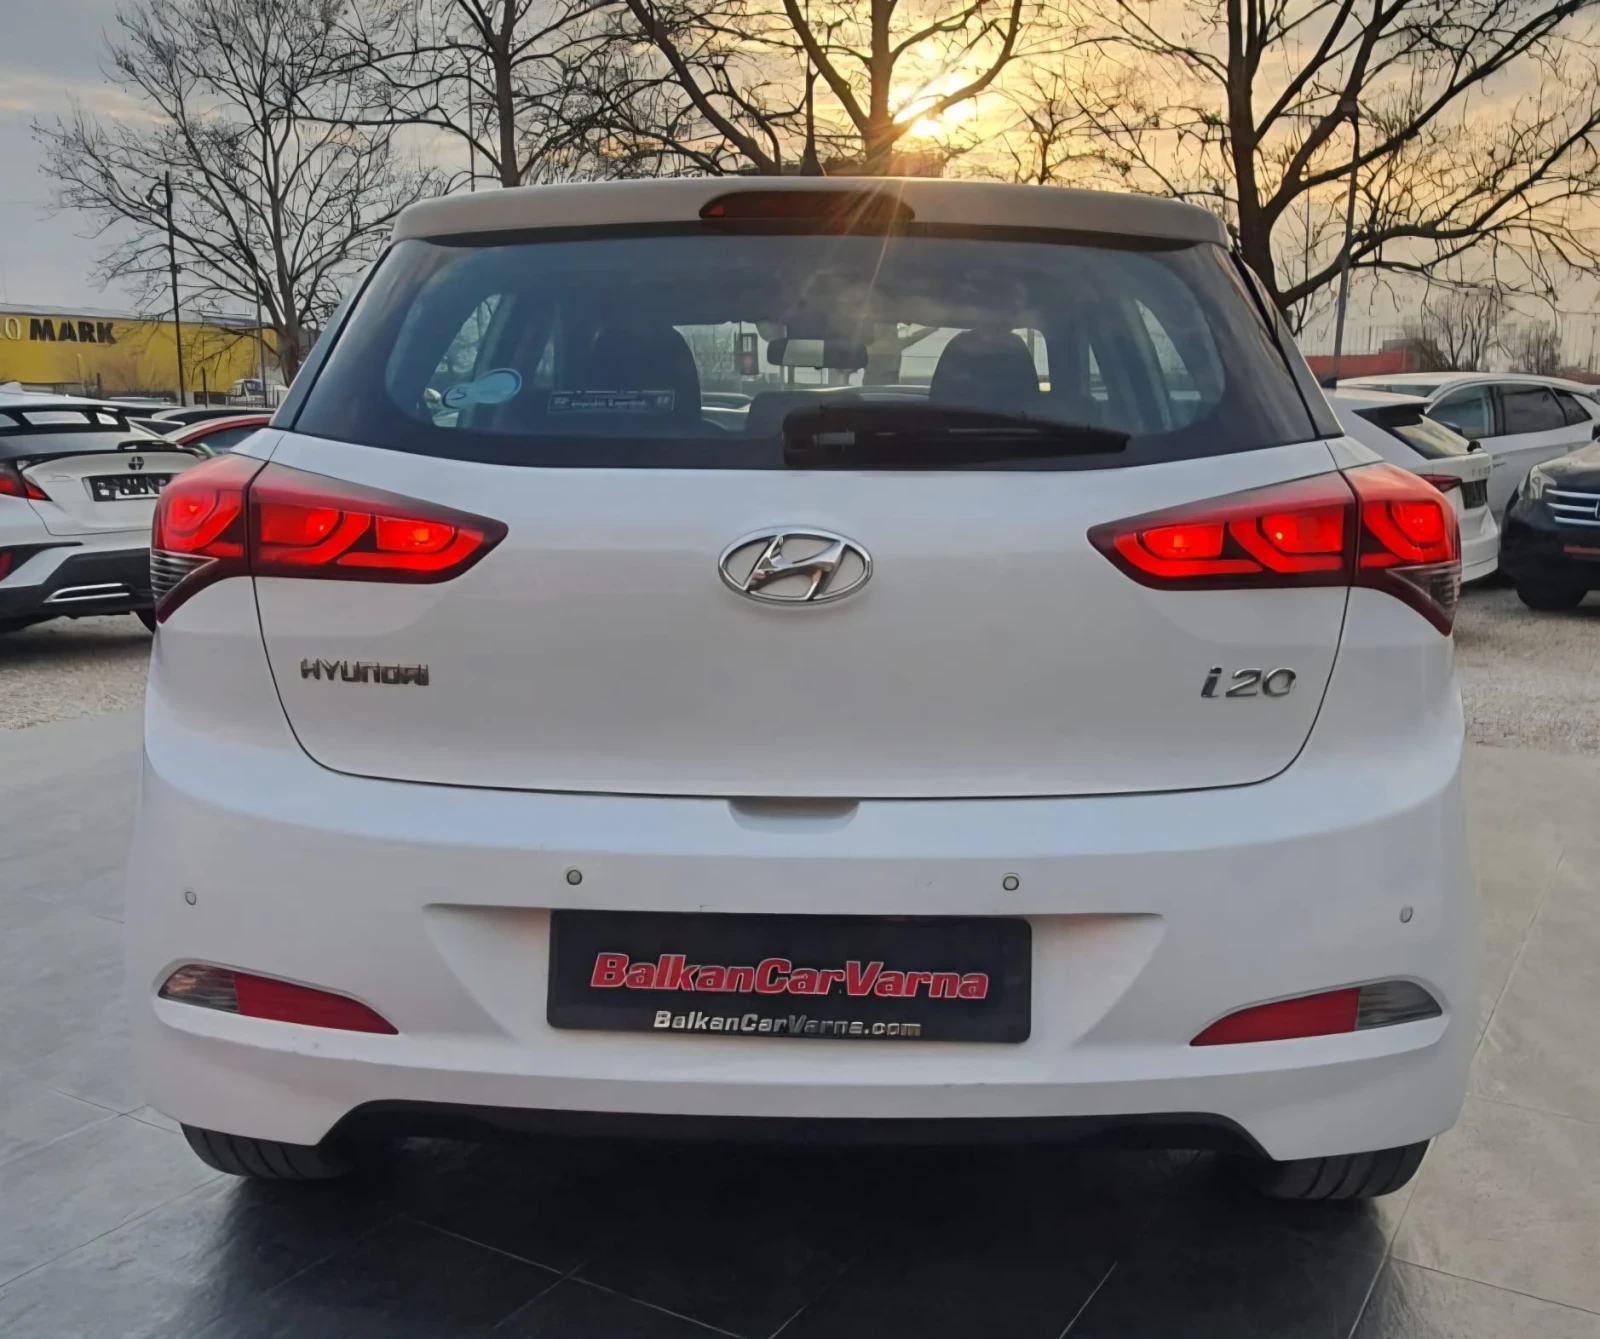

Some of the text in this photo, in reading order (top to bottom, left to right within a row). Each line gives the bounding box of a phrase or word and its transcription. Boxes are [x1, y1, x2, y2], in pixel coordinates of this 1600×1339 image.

[29, 318, 117, 344] MARK
[300, 658, 429, 686] HYUNDAI
[1201, 666, 1296, 698] i20
[590, 952, 989, 999] BalkanCarVarna
[653, 1010, 921, 1037] BalkanCarVarna.com
